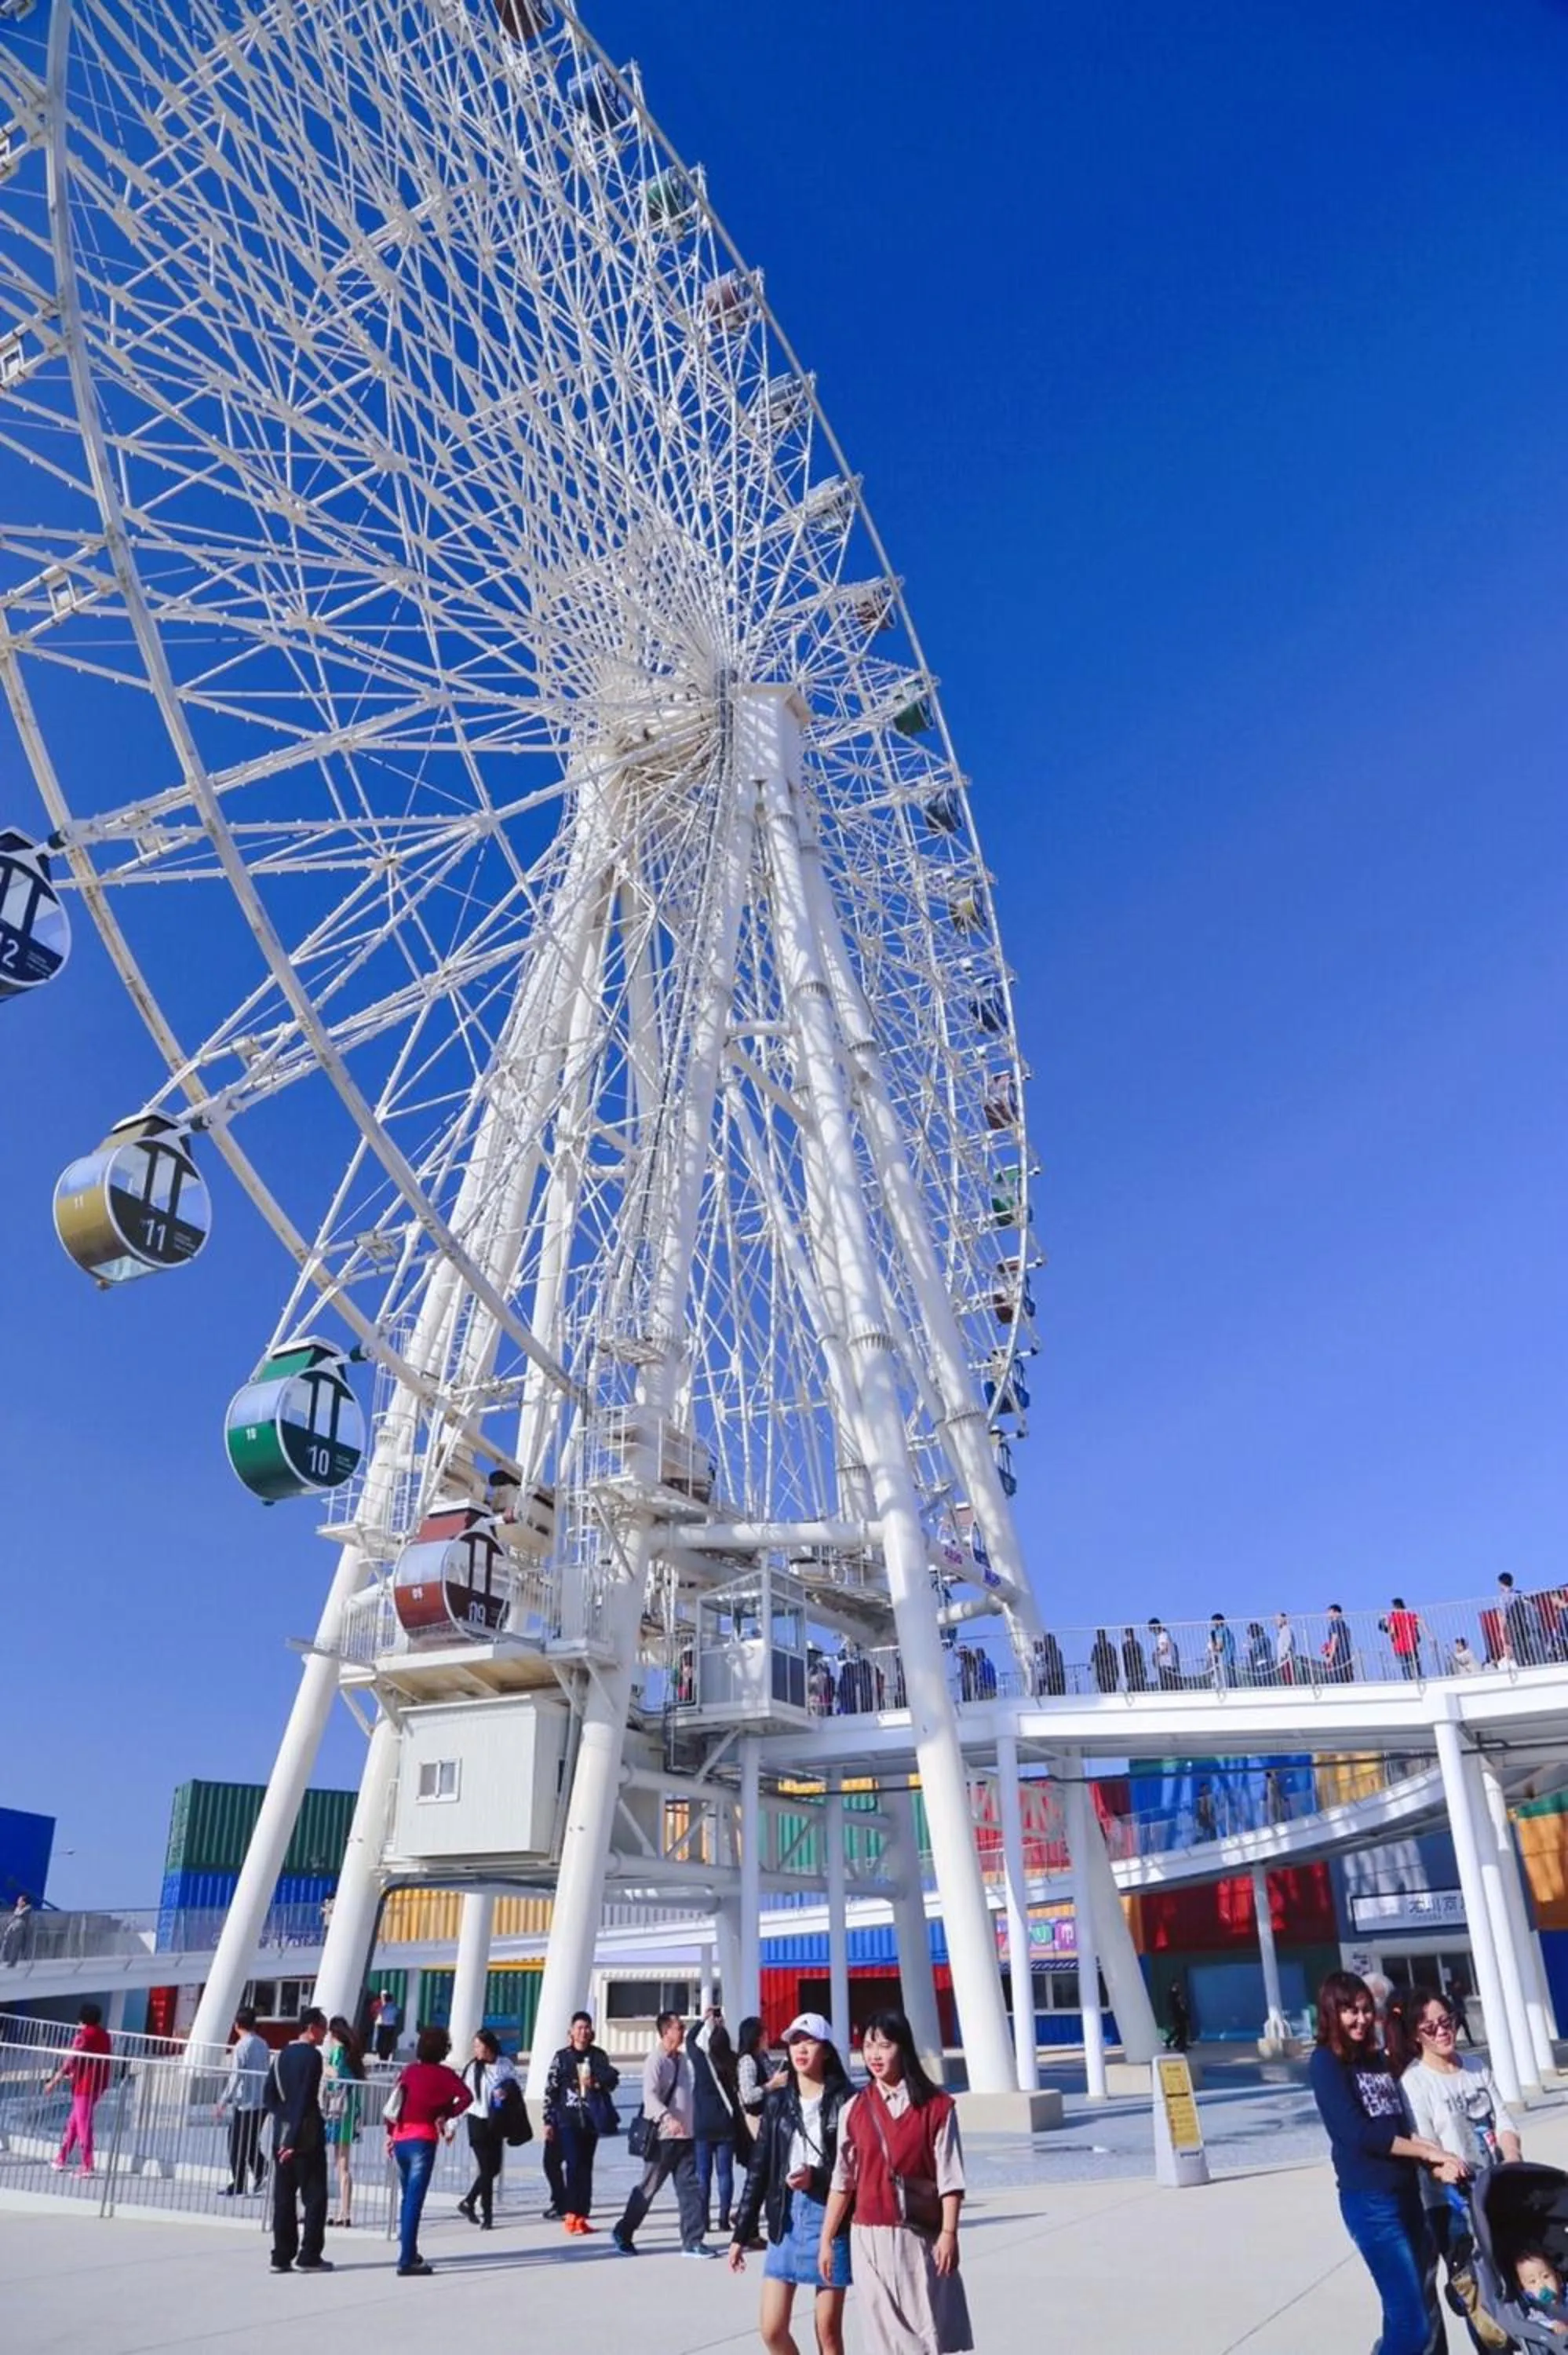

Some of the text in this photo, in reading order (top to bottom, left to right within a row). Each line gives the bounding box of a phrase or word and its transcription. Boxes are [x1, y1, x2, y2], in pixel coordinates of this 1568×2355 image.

[0, 932, 20, 969] 2
[141, 1218, 167, 1252] 11
[307, 1444, 330, 1477] 10
